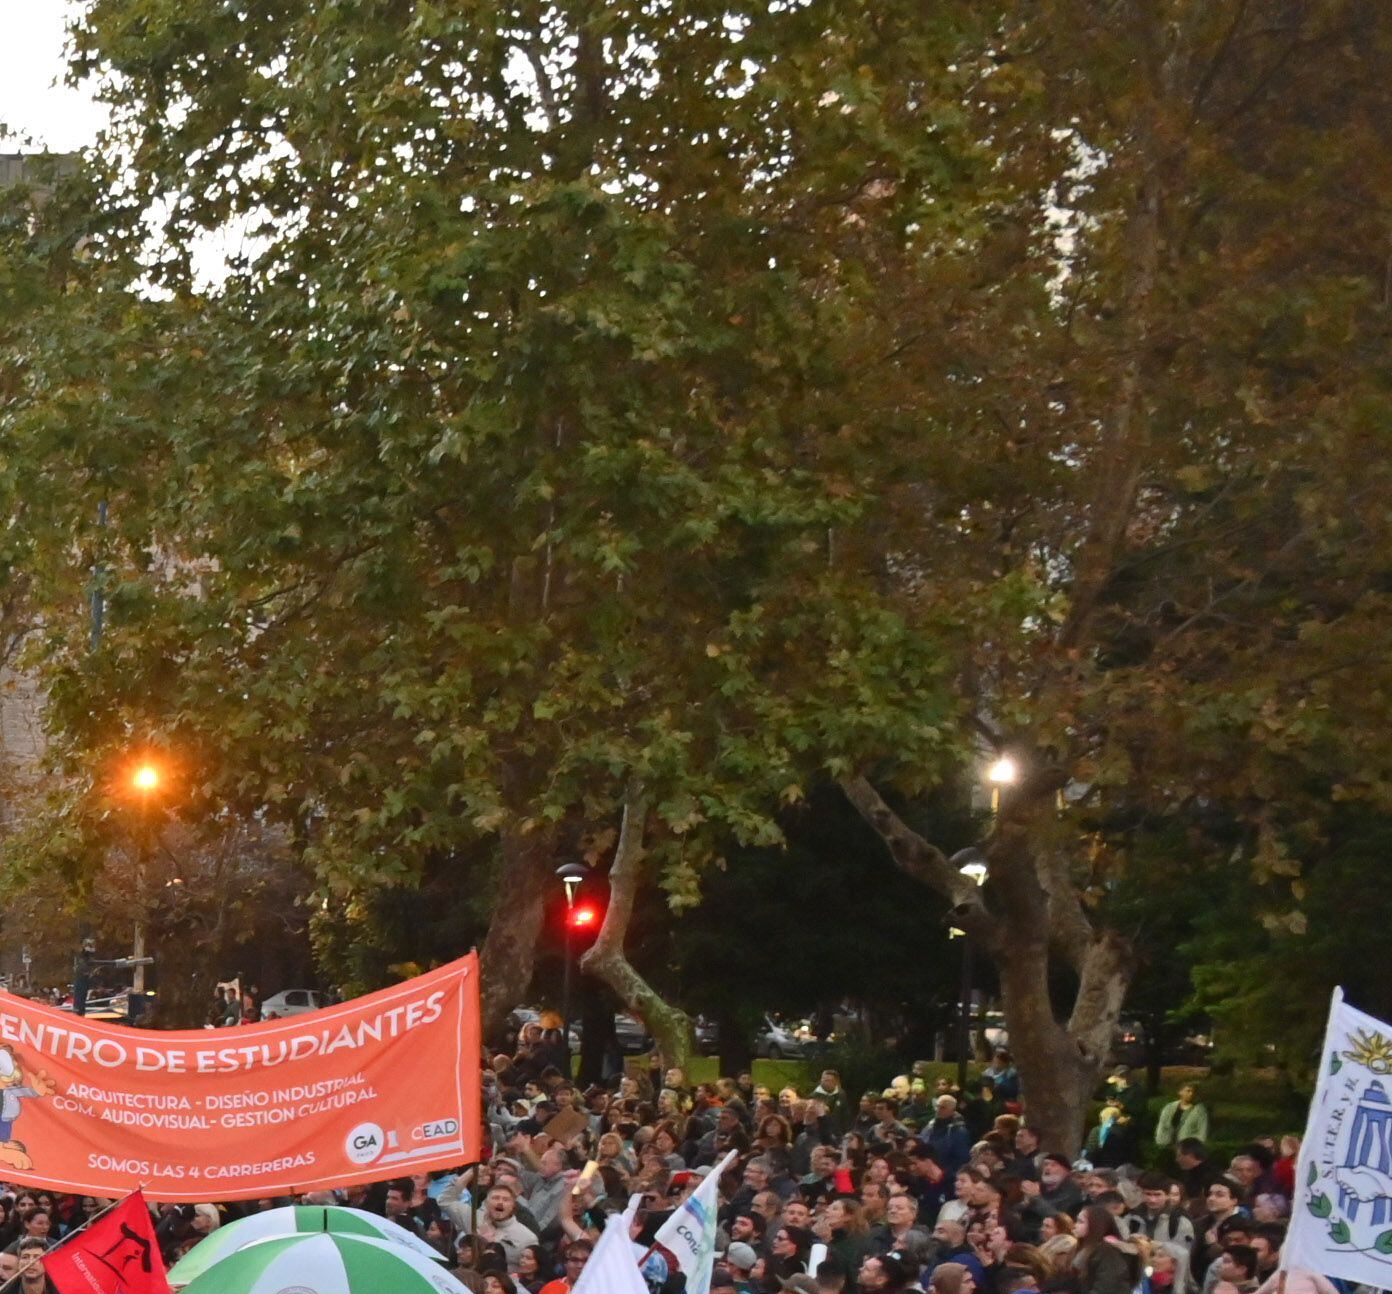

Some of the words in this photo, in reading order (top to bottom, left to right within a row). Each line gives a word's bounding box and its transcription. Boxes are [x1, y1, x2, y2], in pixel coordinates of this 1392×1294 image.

[136, 1047, 186, 1073] DE
[197, 991, 445, 1073] ESTUDIANTES
[67, 1082, 191, 1109] ARQUITECTURA
[206, 1090, 267, 1110] DISEÑO
[273, 1071, 365, 1101] INDUSTRIAL
[53, 1096, 96, 1118] COM.
[221, 1106, 294, 1128] GESTION
[298, 1087, 377, 1118] CULTURAL
[353, 1134, 376, 1149] GA
[411, 1118, 458, 1142] CEAD
[88, 1153, 150, 1176] SOMOS
[153, 1164, 185, 1178] LAS
[189, 1165, 199, 1178] 4
[204, 1152, 316, 1178] CARRERERAS
